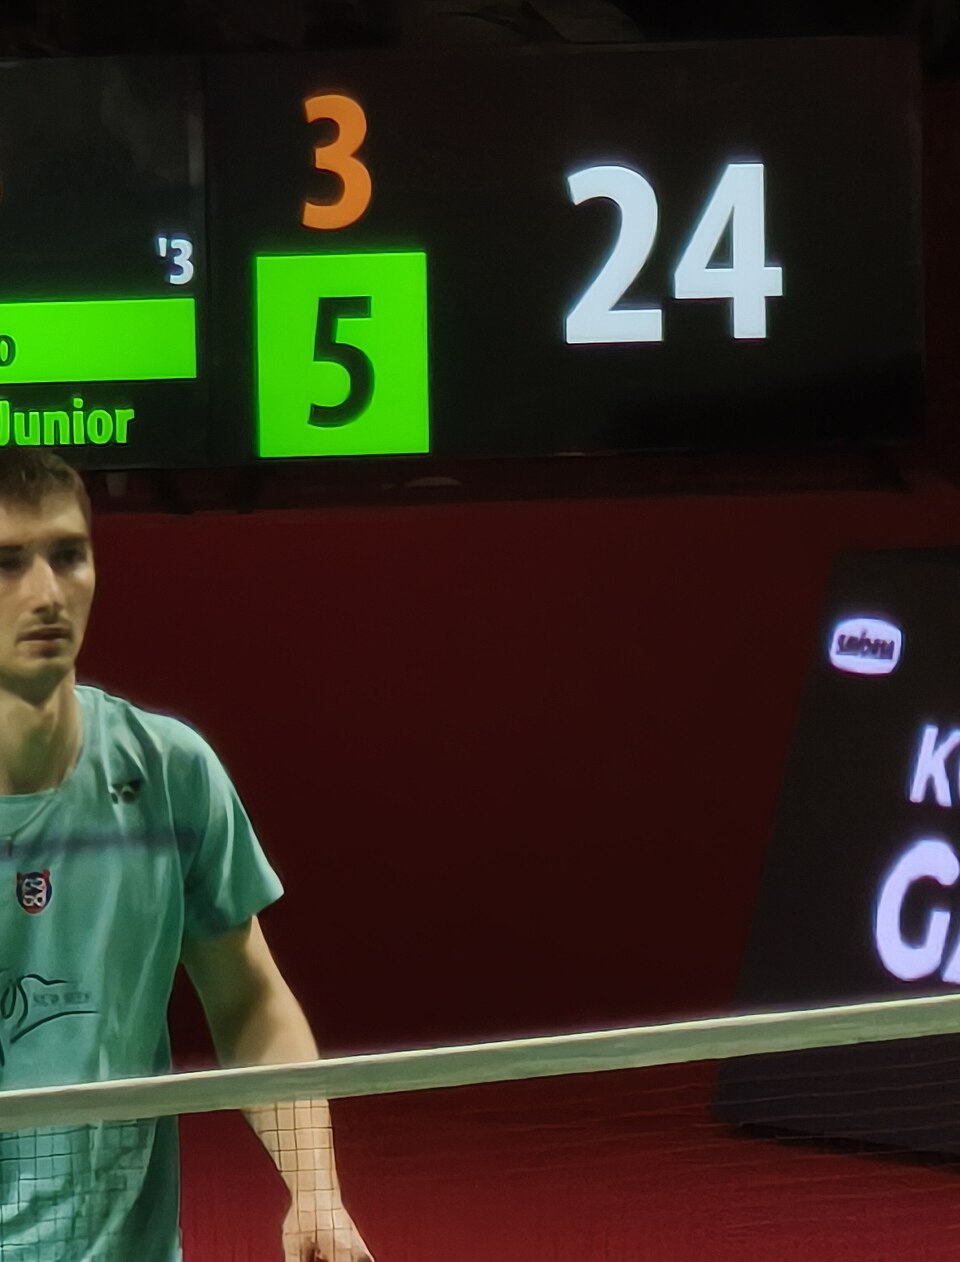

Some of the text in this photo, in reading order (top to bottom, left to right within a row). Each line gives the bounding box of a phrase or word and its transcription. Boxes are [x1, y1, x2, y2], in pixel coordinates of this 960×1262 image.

[301, 93, 372, 230] 3
[564, 163, 784, 345] 24
[306, 295, 375, 429] 5
